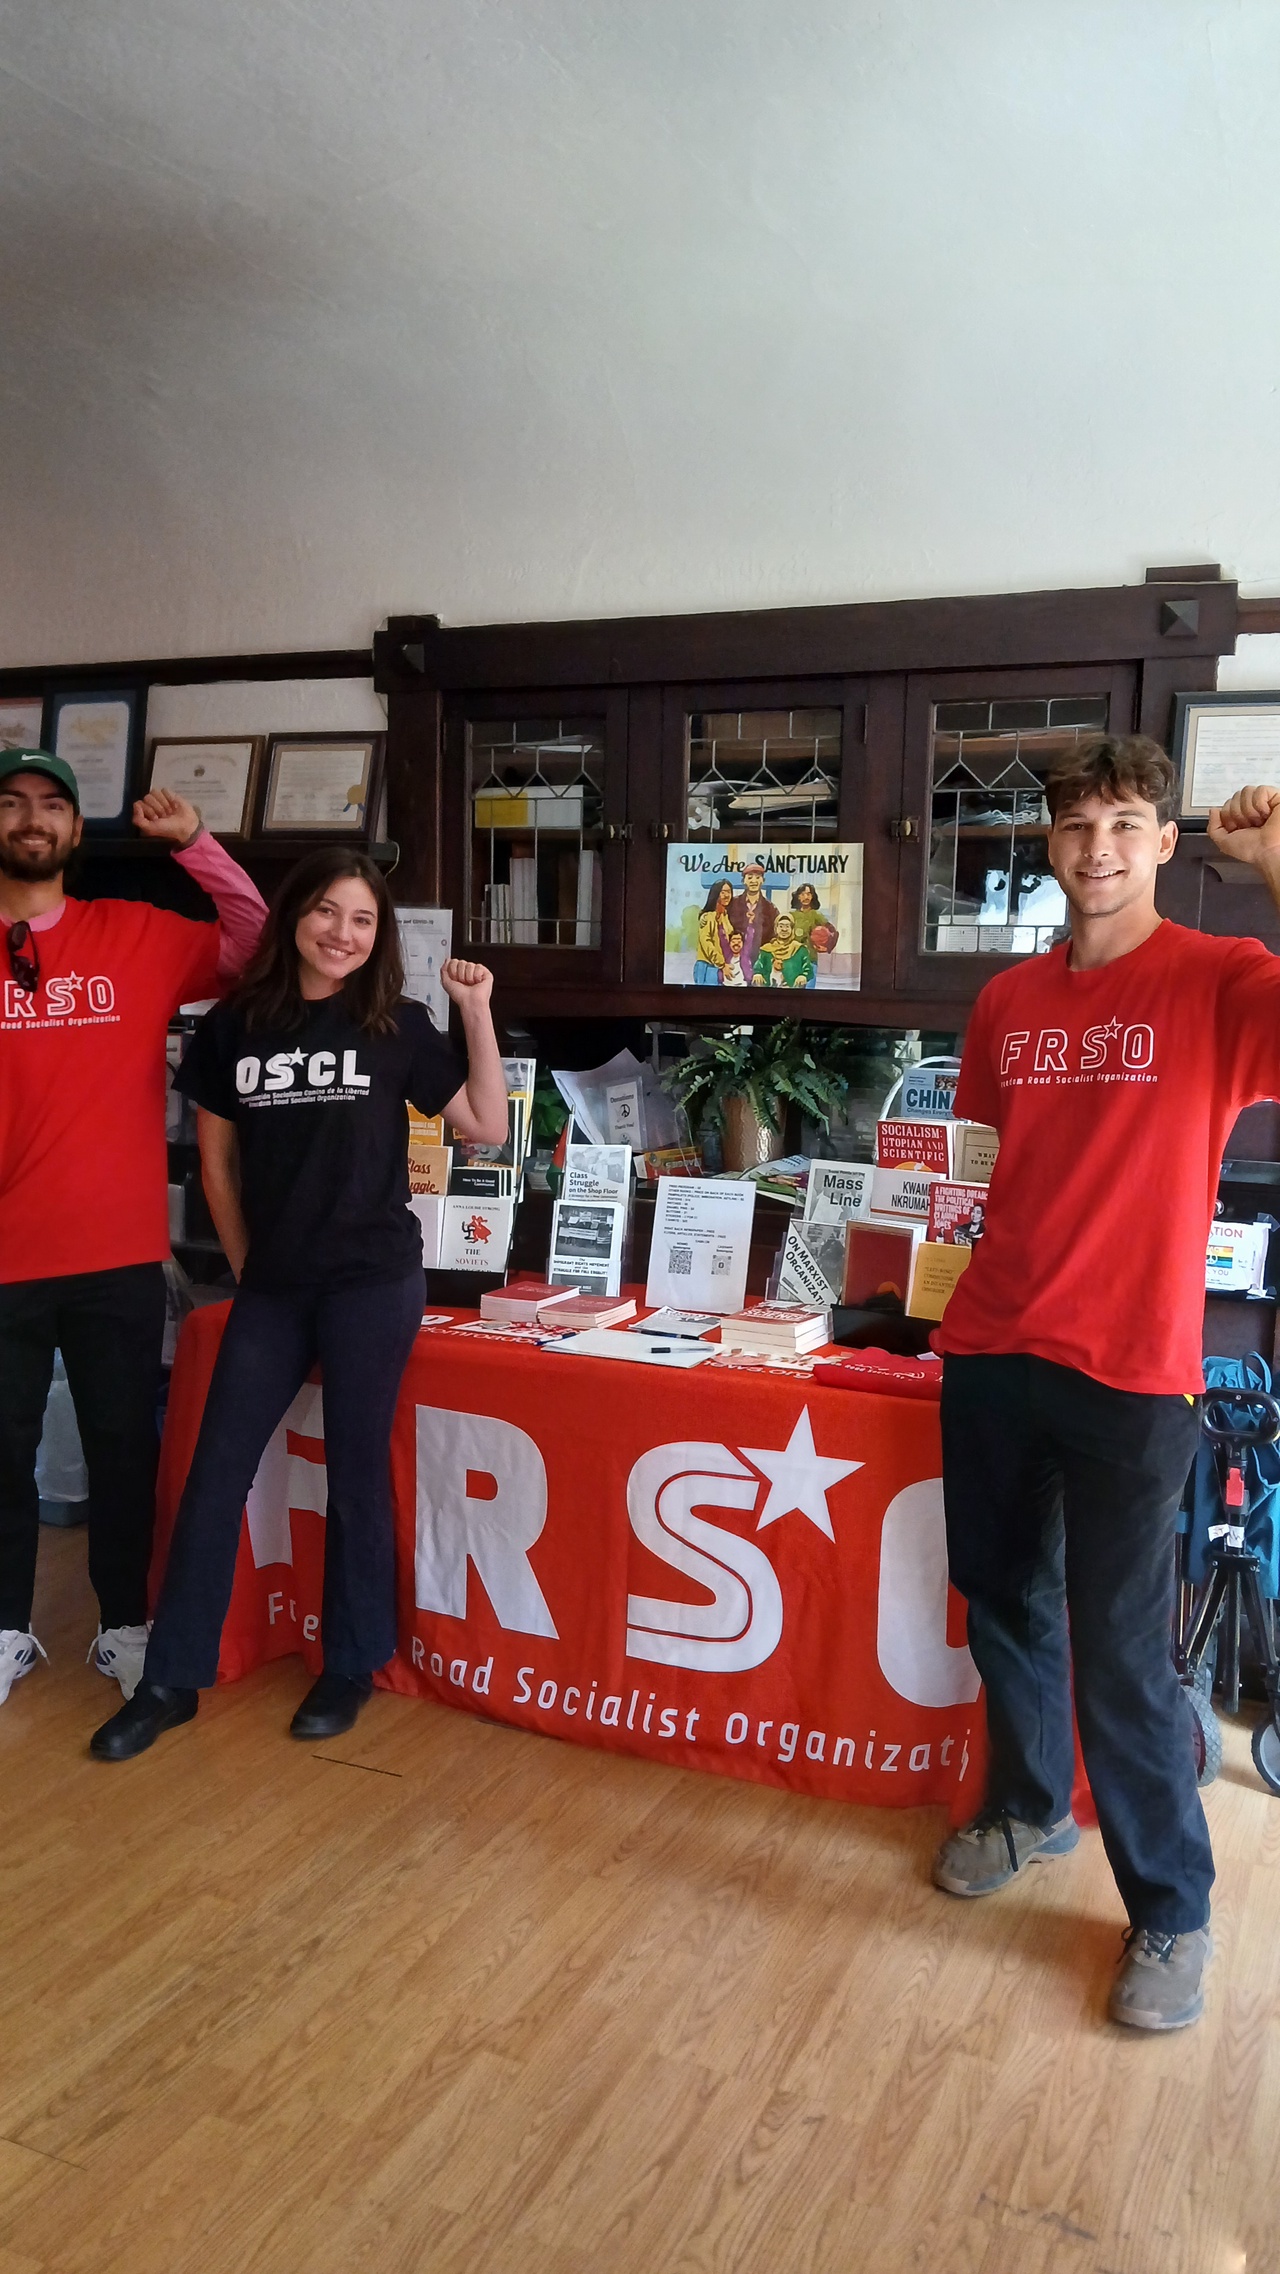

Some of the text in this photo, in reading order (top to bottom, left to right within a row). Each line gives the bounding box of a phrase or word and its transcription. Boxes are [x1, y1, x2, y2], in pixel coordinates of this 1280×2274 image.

[680, 852, 849, 874] We Are SANCTUARY
[236, 1050, 371, 1095] OSCL
[1027, 1075, 1051, 1085] Road
[1056, 1073, 1094, 1084] Socialist
[1097, 1071, 1158, 1084] Organization
[327, 1087, 335, 1095] de
[337, 1086, 344, 1094] la
[906, 1088, 954, 1111] CHIN
[881, 1124, 943, 1139] SOCIALISM:
[882, 1137, 944, 1151] UTOPIAN AND
[882, 1149, 945, 1162] SCIENTIFIC
[569, 1171, 588, 1179] Class
[823, 1174, 863, 1191] Mass
[410, 1180, 439, 1195] uggle
[569, 1179, 600, 1188] Struggle
[587, 1187, 602, 1195] Shop
[830, 1192, 862, 1208] Line
[788, 1236, 801, 1252] ON
[465, 1248, 480, 1256] THE
[455, 1258, 489, 1266] SOVIETS
[797, 1250, 829, 1291] MARXIST
[785, 1251, 826, 1306] ORGANIZATI
[411, 1636, 971, 1782] Road Socialist Organizati
